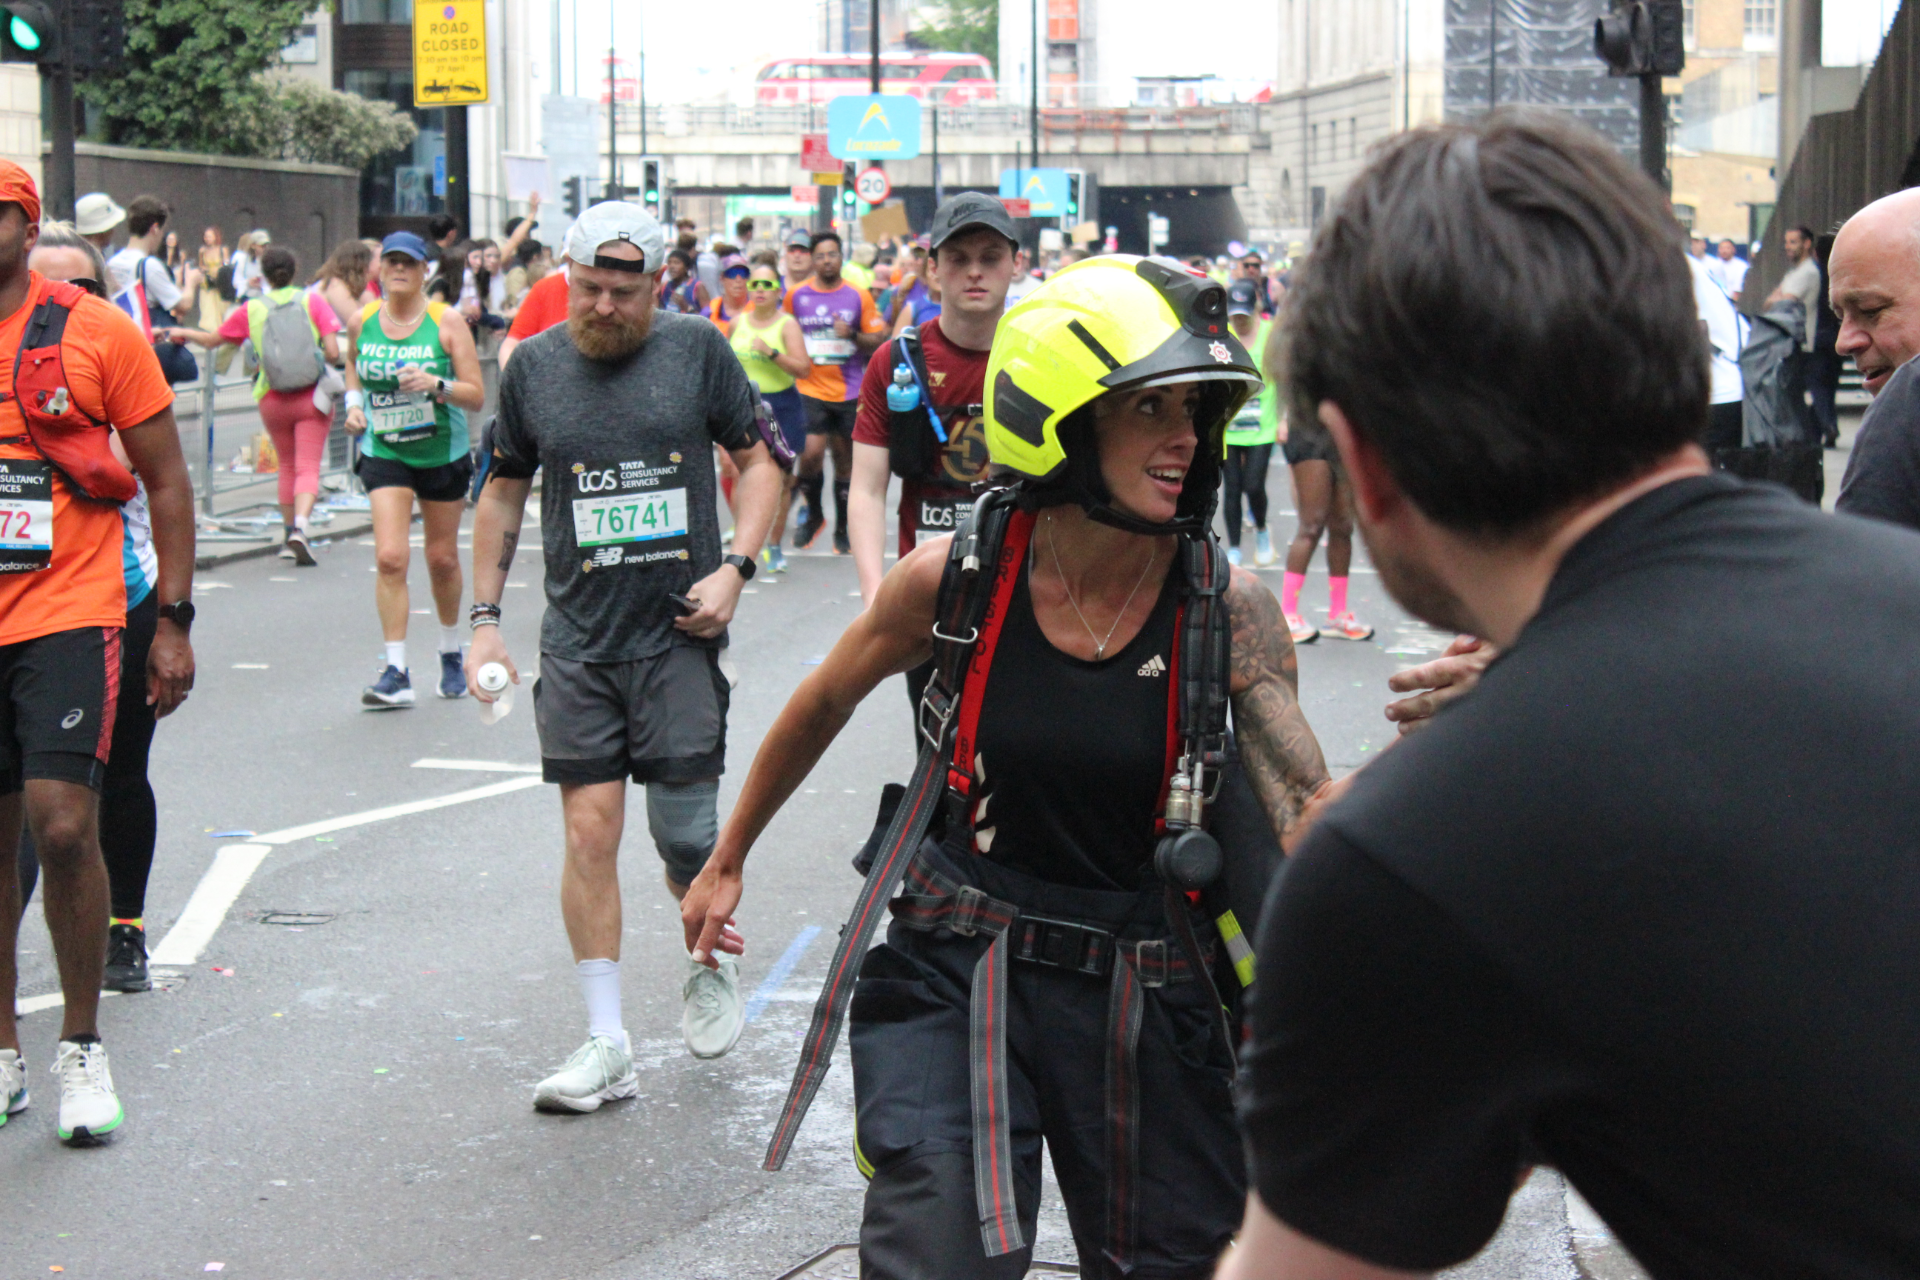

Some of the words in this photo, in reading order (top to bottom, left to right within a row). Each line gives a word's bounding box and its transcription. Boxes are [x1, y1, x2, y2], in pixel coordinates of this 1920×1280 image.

[430, 22, 469, 35] ROAD
[422, 38, 479, 52] CLOSED
[861, 179, 885, 194] 20
[361, 343, 435, 359] VICTORIA
[356, 360, 438, 381] NSPC
[381, 408, 424, 428] 77720
[619, 460, 645, 471] TATA
[620, 466, 678, 480] CONSULTANCY
[621, 477, 660, 489] SERVICES
[591, 500, 669, 536] 76741
[624, 554, 644, 565] new
